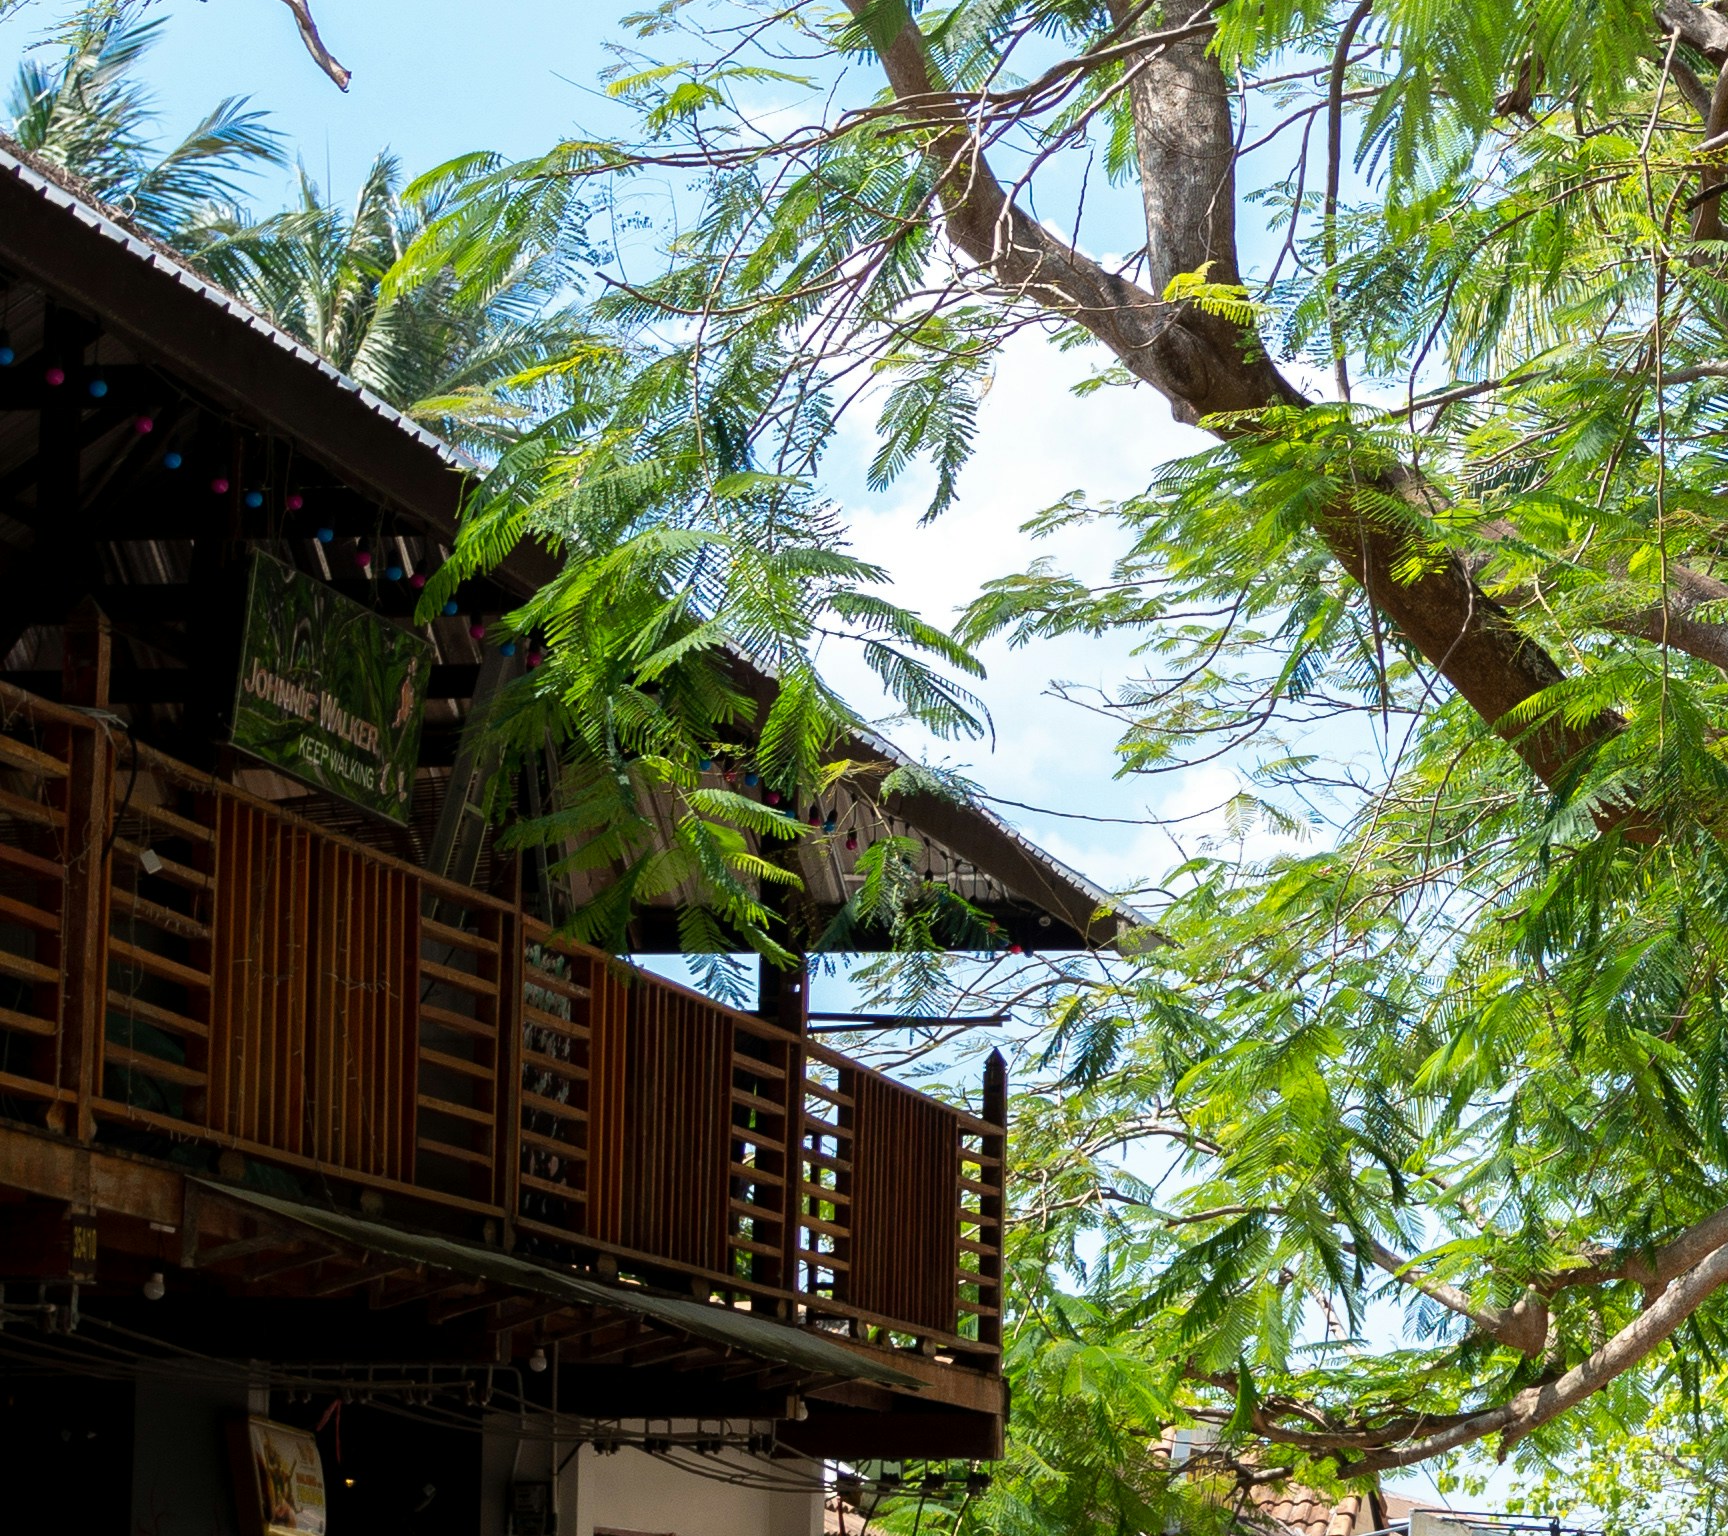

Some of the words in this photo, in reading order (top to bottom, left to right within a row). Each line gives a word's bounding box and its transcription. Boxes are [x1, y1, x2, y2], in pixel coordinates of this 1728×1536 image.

[244, 657, 319, 722] JOHNNIE
[320, 690, 380, 755] WALKER
[298, 733, 329, 766] KEEP
[329, 747, 375, 791] WALKING
